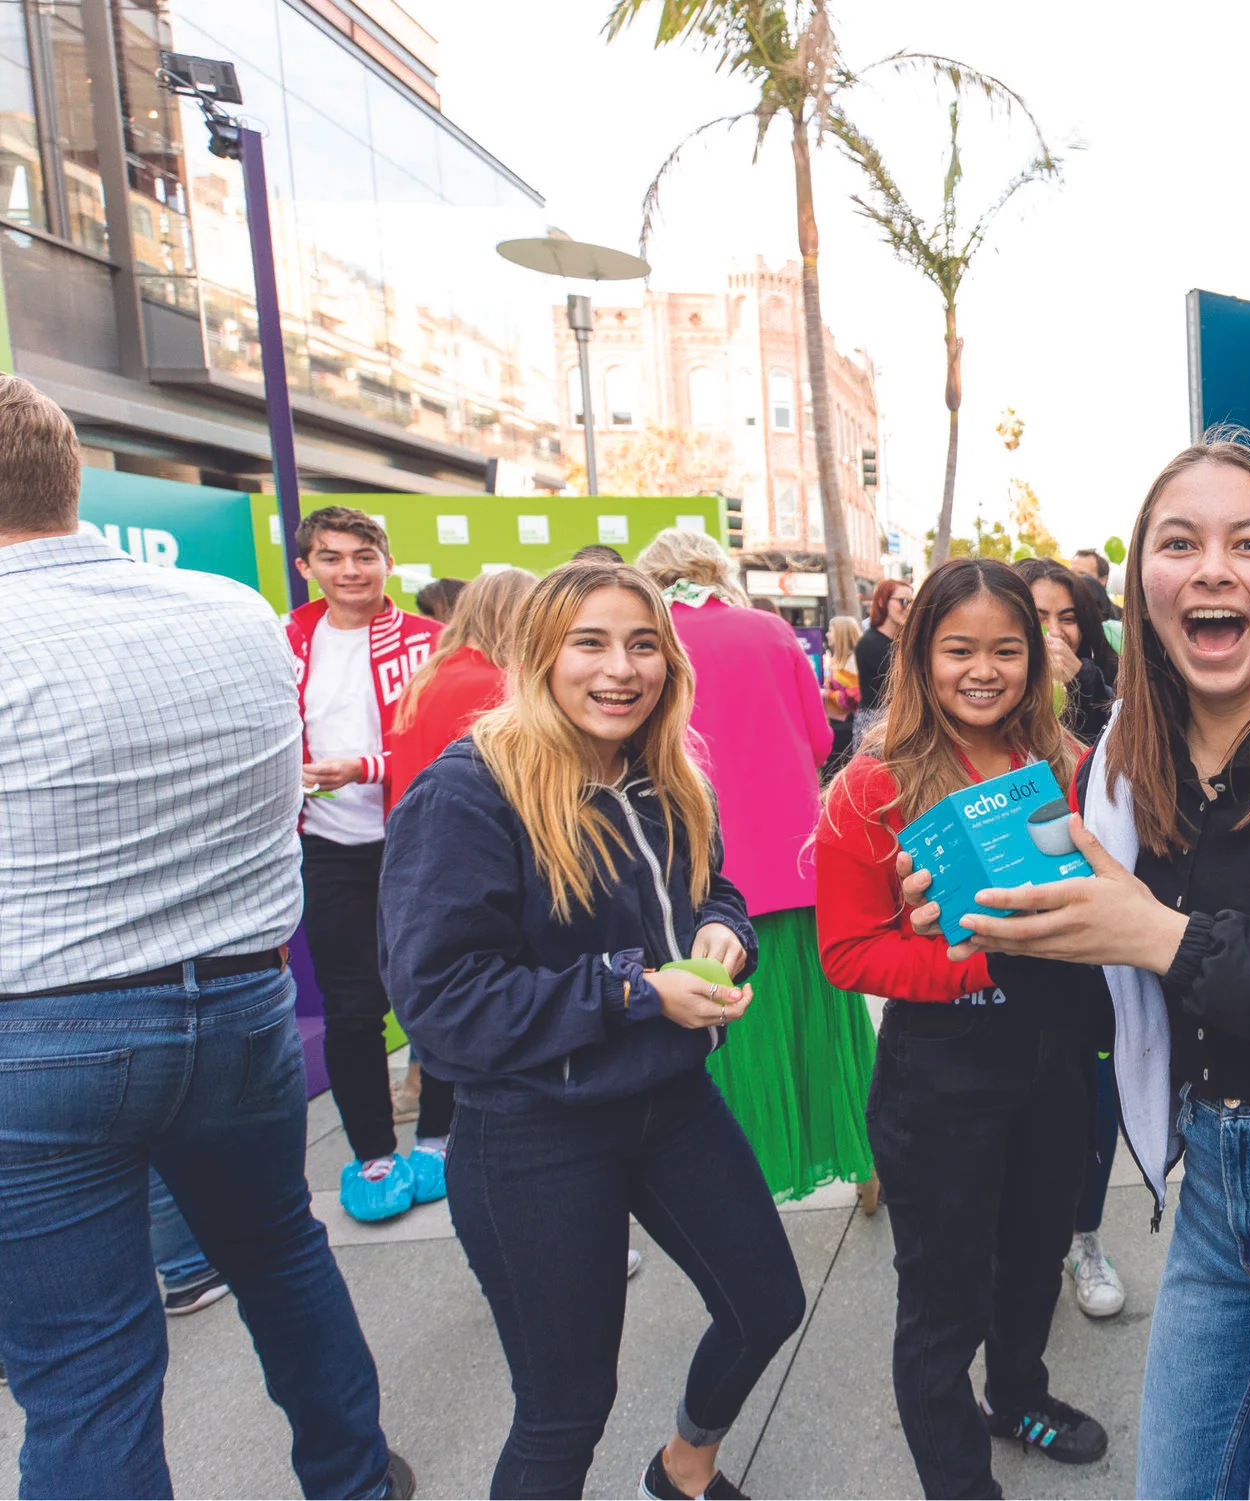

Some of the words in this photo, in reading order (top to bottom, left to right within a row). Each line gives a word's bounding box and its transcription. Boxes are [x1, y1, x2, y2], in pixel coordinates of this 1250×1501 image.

[79, 520, 179, 568] UR
[964, 793, 1008, 819] echo
[1009, 778, 1039, 802] dot
